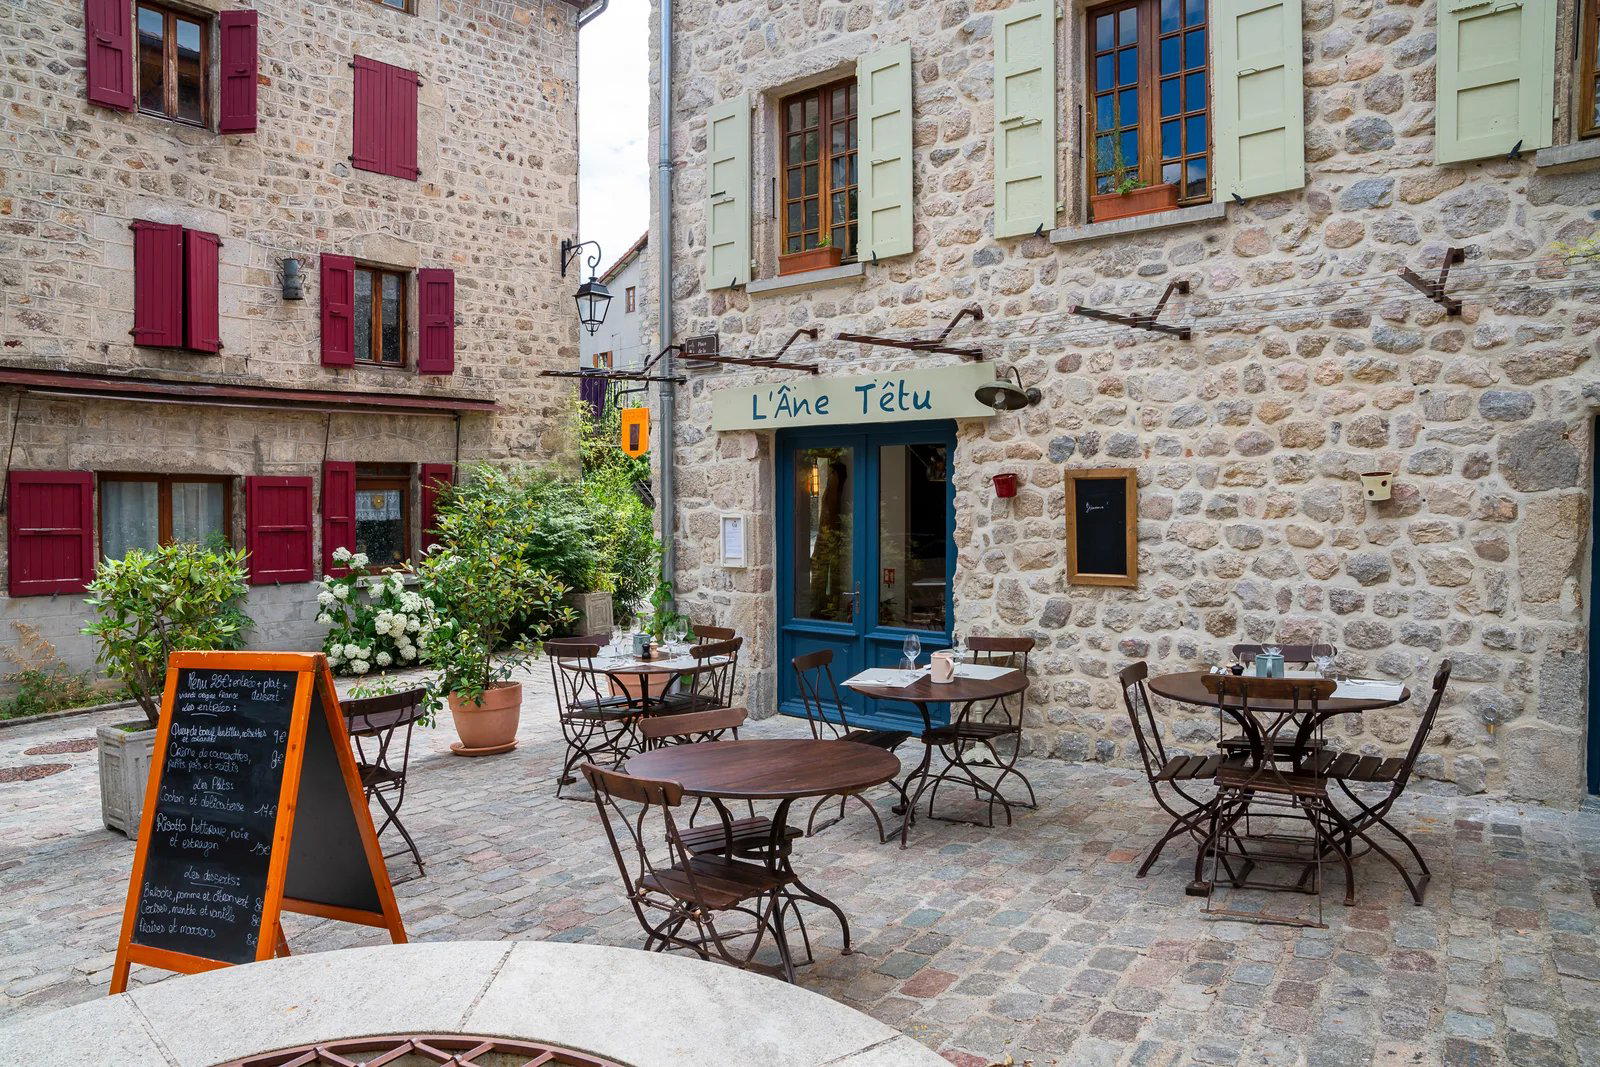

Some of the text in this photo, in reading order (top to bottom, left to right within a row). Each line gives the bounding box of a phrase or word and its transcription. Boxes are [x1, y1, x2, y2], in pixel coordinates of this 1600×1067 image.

[753, 379, 932, 420] L'Âne Têtu
[188, 672, 208, 689] Menu
[263, 677, 281, 693] plat
[189, 793, 199, 805] et
[157, 813, 186, 832] Risotto
[169, 833, 178, 847] et
[203, 893, 212, 902] et
[200, 905, 209, 916] et
[169, 917, 178, 933] et
